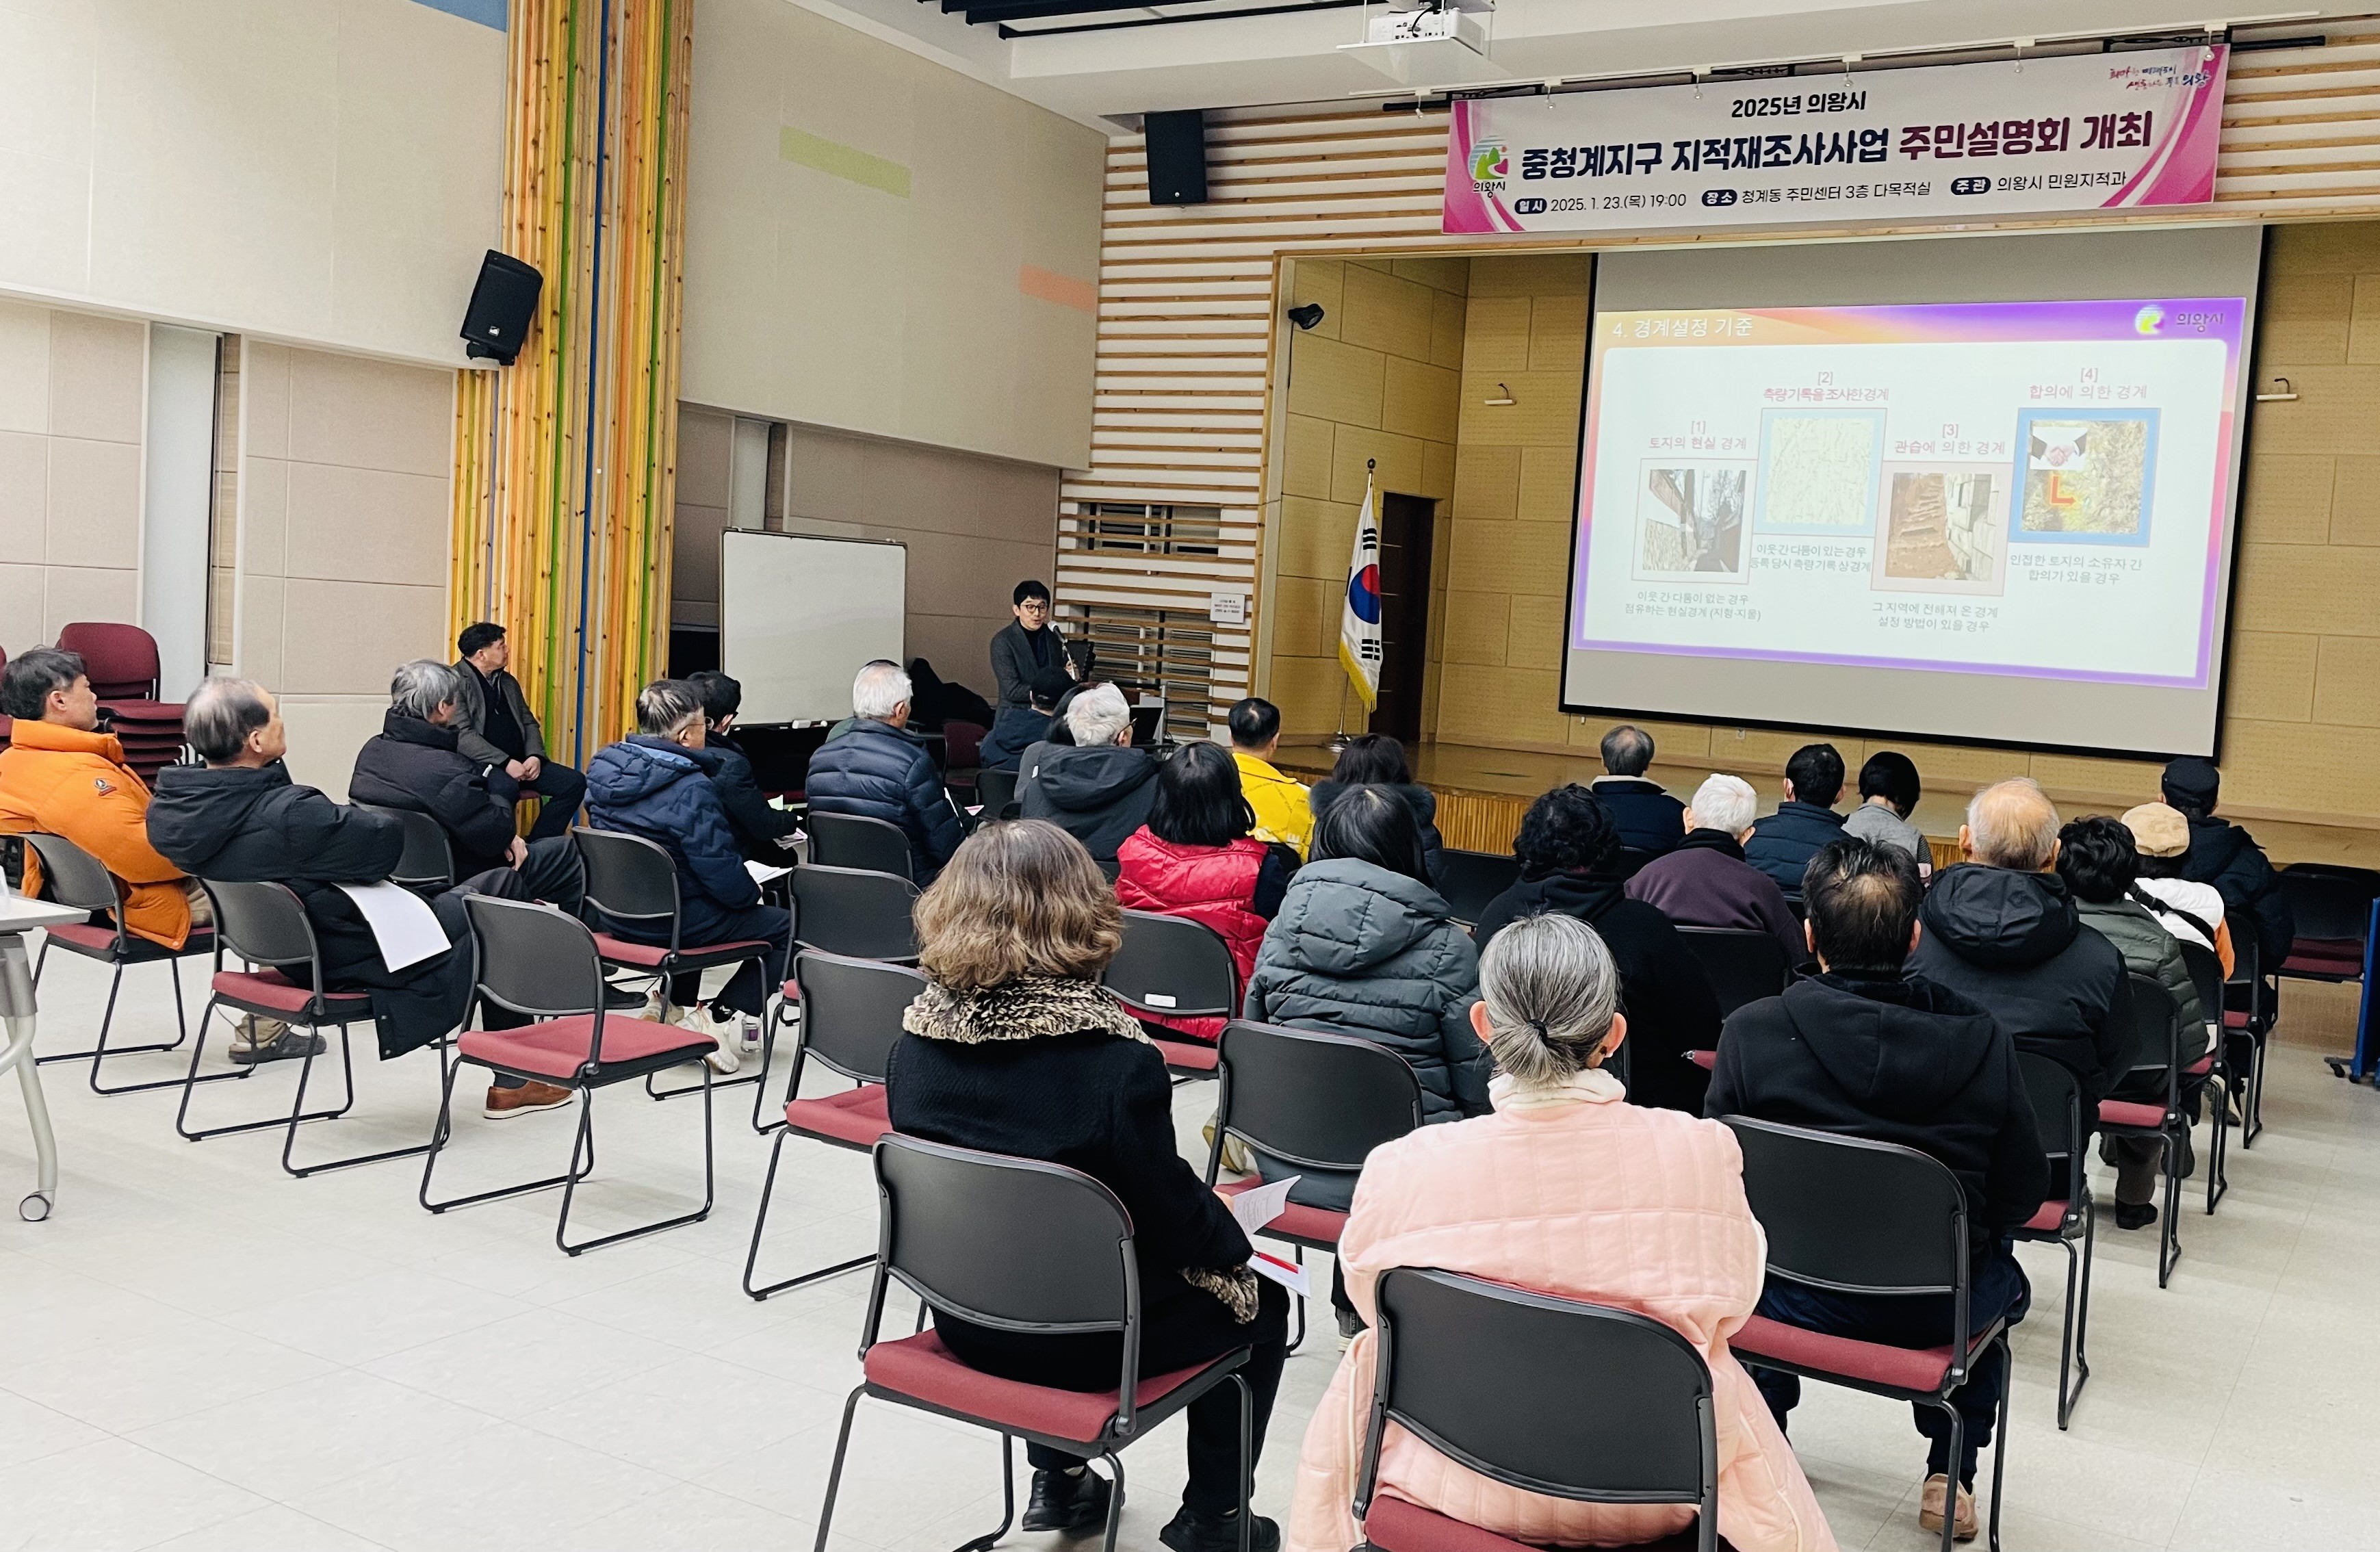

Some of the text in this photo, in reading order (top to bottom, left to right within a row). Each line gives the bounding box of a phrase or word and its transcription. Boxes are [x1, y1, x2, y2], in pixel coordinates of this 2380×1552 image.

[2182, 70, 2210, 87] 의왕
[1731, 90, 1866, 118] 2025년 의왕시
[1521, 111, 2153, 181] 중청계지구 지적재조사사업 주민설명회 개최
[1473, 180, 1506, 199] 의왕시
[1519, 171, 2127, 213] 일시 2025. 1. 23.(목) 19:00 장소 청계동 주민센터 3층 다목적실 주관 의왕시 민원지적과
[1613, 318, 1754, 339] 4. 경계설정 기준
[2176, 313, 2224, 333] 의왕시
[1818, 372, 1833, 385] [2]
[2080, 367, 2098, 383] [4]
[2030, 385, 2148, 400] 합의에 의한 경계
[1692, 421, 1706, 434] [1]
[1943, 424, 1958, 439] [3]
[1649, 436, 1747, 450] 토지의 현실 경계
[1894, 441, 2005, 455] 관습에 의한 경계
[2010, 554, 2141, 571] 인접한 토지의 소유자 간
[2029, 569, 2120, 585] 합의가 있을 경우
[1873, 602, 1884, 612] 그
[1887, 602, 1919, 613] 지역에
[1975, 605, 1998, 618] 경계
[1878, 616, 1900, 628] 설정
[1967, 620, 1990, 632] 경우
